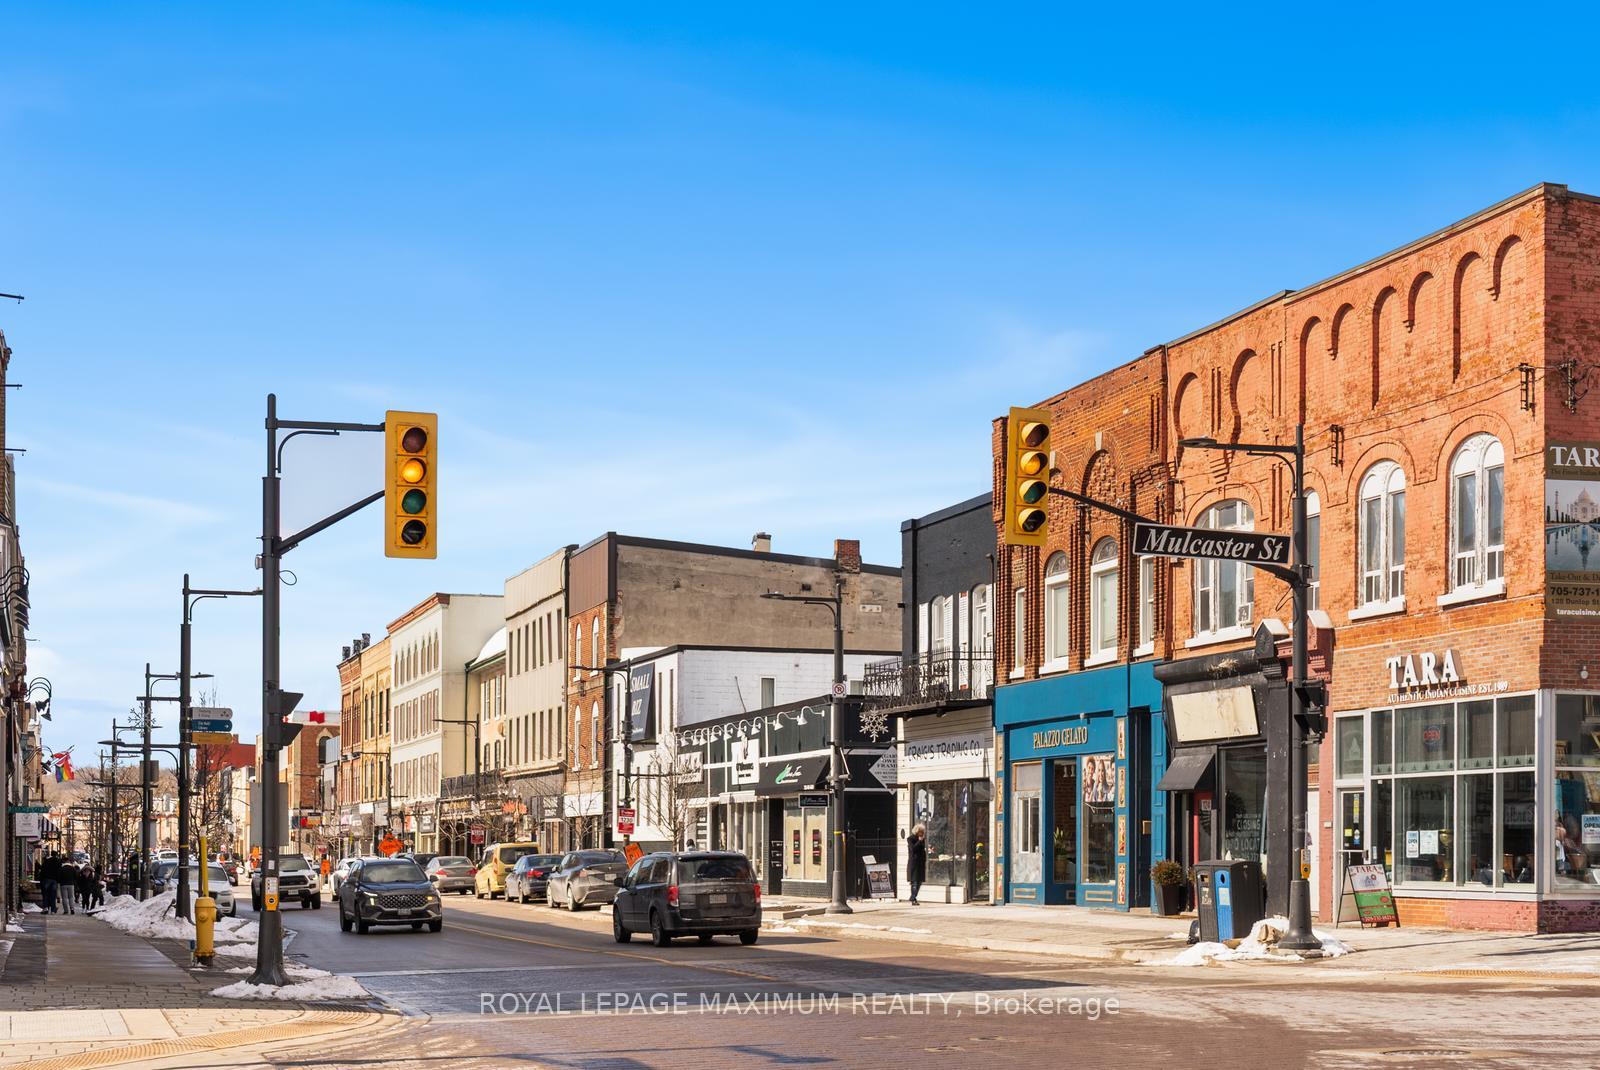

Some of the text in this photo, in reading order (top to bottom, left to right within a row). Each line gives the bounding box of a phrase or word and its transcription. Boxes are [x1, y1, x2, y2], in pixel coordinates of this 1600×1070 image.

[1142, 529, 1283, 560] Mulcaster St
[1386, 649, 1459, 689] TARA
[631, 673, 650, 692] SMALL
[1387, 691, 1424, 704] AUTHENTIC
[1425, 688, 1449, 699] INDIAN
[1449, 685, 1477, 697] CUISINE
[1033, 726, 1088, 749] PALAZZO GELATO
[908, 739, 982, 761] CRAIG'S TRADING CO.
